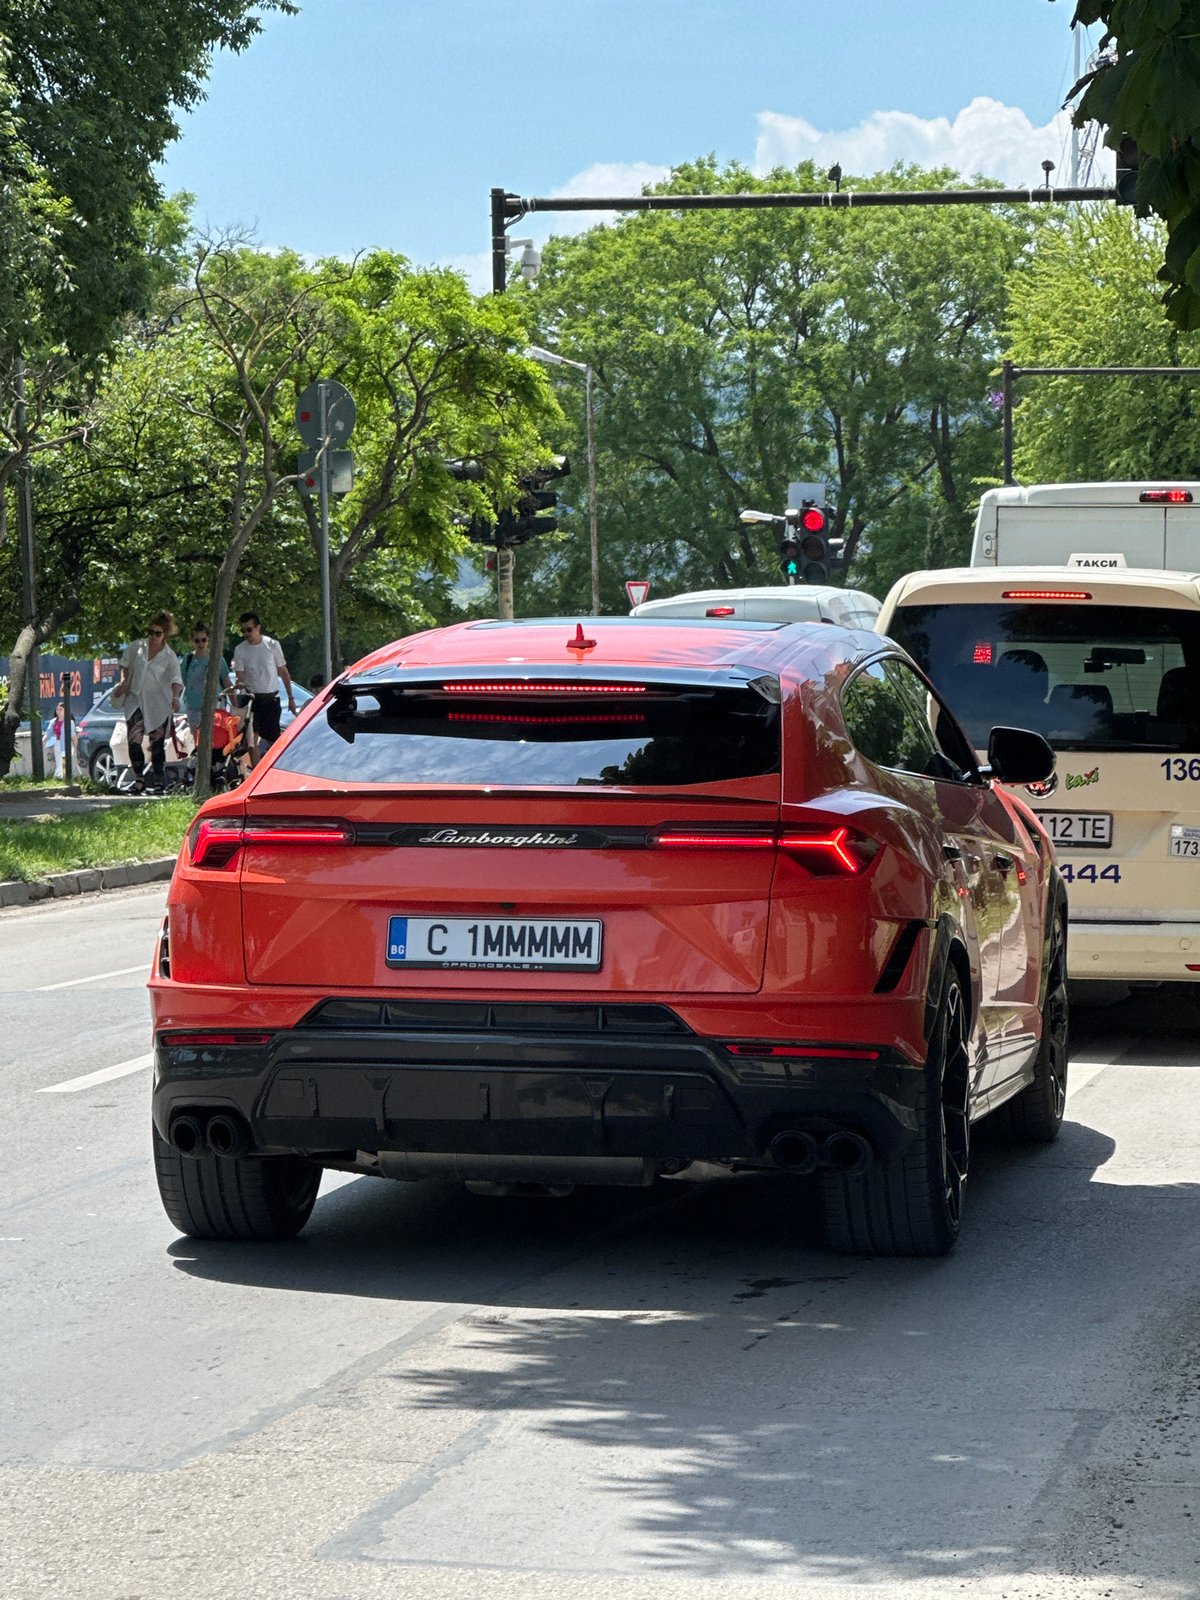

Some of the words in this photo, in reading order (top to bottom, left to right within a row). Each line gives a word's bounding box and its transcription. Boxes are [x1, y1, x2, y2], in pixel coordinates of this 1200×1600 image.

[1075, 559, 1118, 568] ТАКСИ
[59, 671, 82, 697] 226
[1160, 758, 1200, 781] 136
[418, 829, 578, 847] Lamborghini
[1078, 817, 1106, 839] TE
[1174, 839, 1200, 856] 173
[390, 944, 405, 955] BG
[427, 924, 448, 956] C
[467, 924, 594, 959] 1MMMMM
